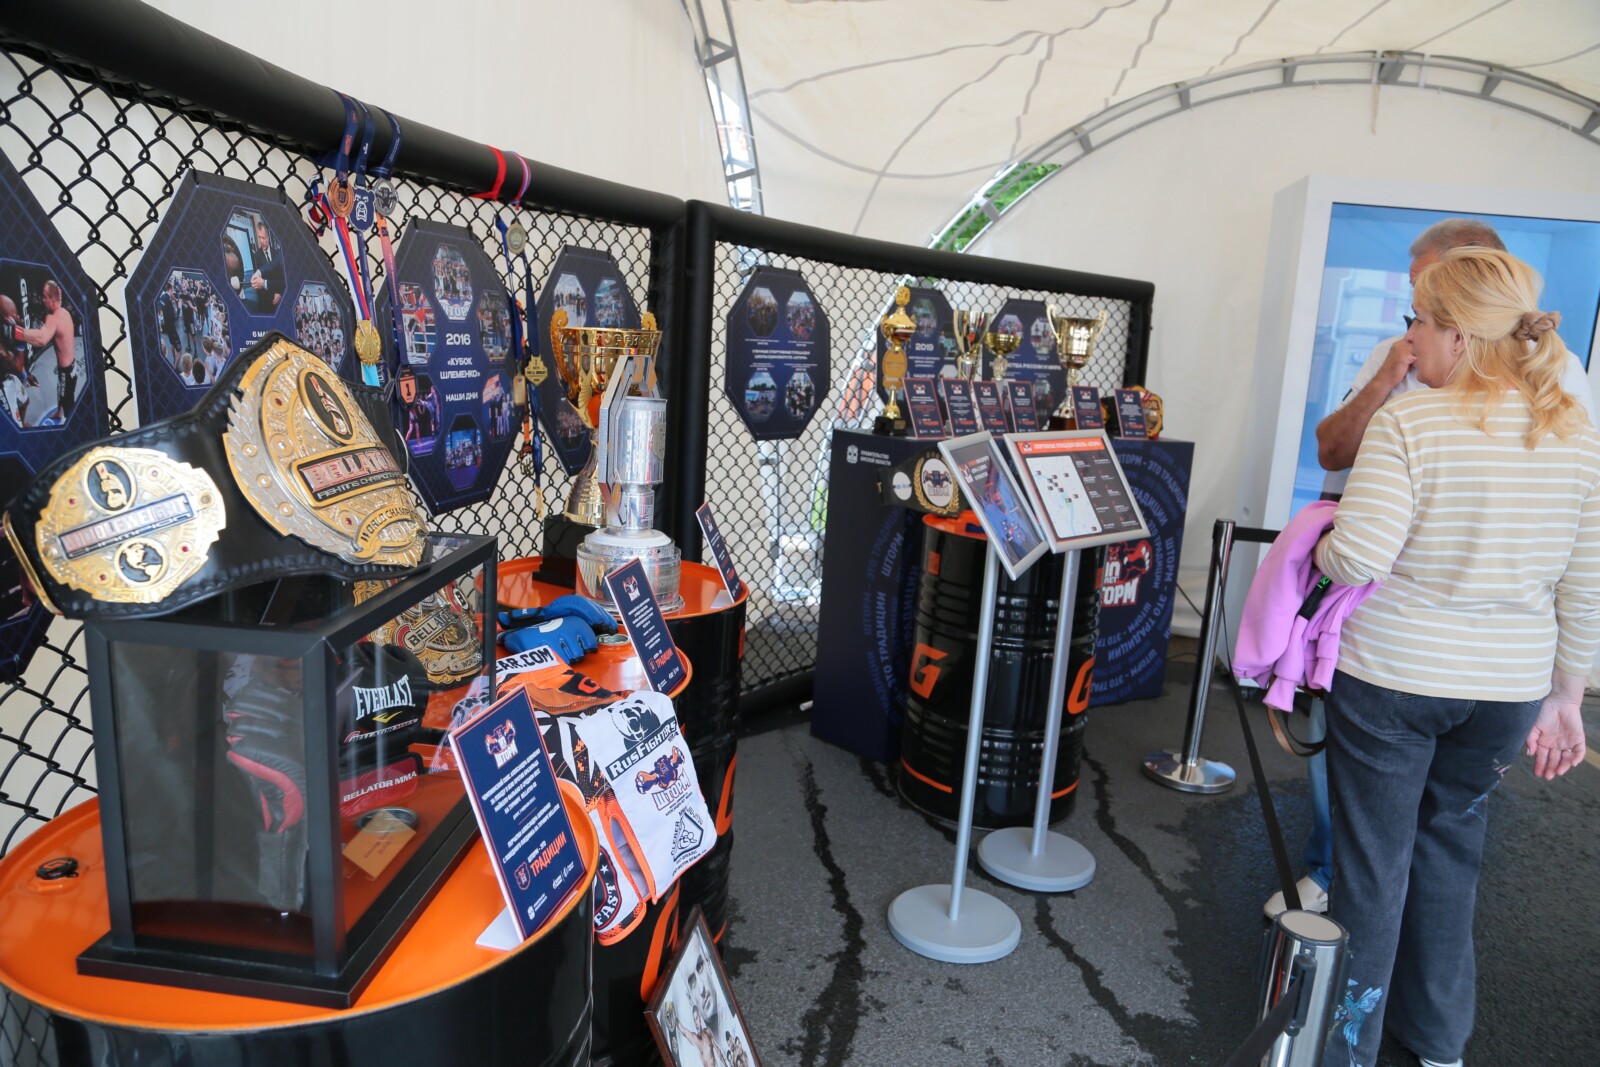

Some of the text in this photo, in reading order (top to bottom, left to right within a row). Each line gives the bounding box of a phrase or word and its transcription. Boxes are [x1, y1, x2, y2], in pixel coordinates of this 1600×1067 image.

[446, 333, 471, 346] 2016
[914, 342, 934, 352] 2019
[440, 370, 480, 380] ШЛЕМЕНКО»
[448, 358, 472, 366] «КУБОК
[406, 383, 412, 396] 1
[446, 392, 478, 402] НАШИ ДНИ
[317, 481, 360, 499] FIGHTING
[360, 514, 387, 542] WORLD
[881, 532, 904, 578] ШТОРМ
[1165, 537, 1175, 582] ШТОРМ
[1102, 576, 1139, 605] ОРМ
[1153, 594, 1168, 617] ЭТО
[876, 591, 889, 662] ТРАДИЦИИ
[1108, 617, 1156, 662] ТРАДИЦИИ
[883, 664, 896, 688] ЭТО
[352, 674, 416, 720] EVERLAST
[344, 770, 418, 802] BELLATOR MMA
[653, 772, 692, 812] ШТОРМ
[530, 831, 568, 877] ТРАДИЦИИ
[594, 882, 618, 926] FAST
